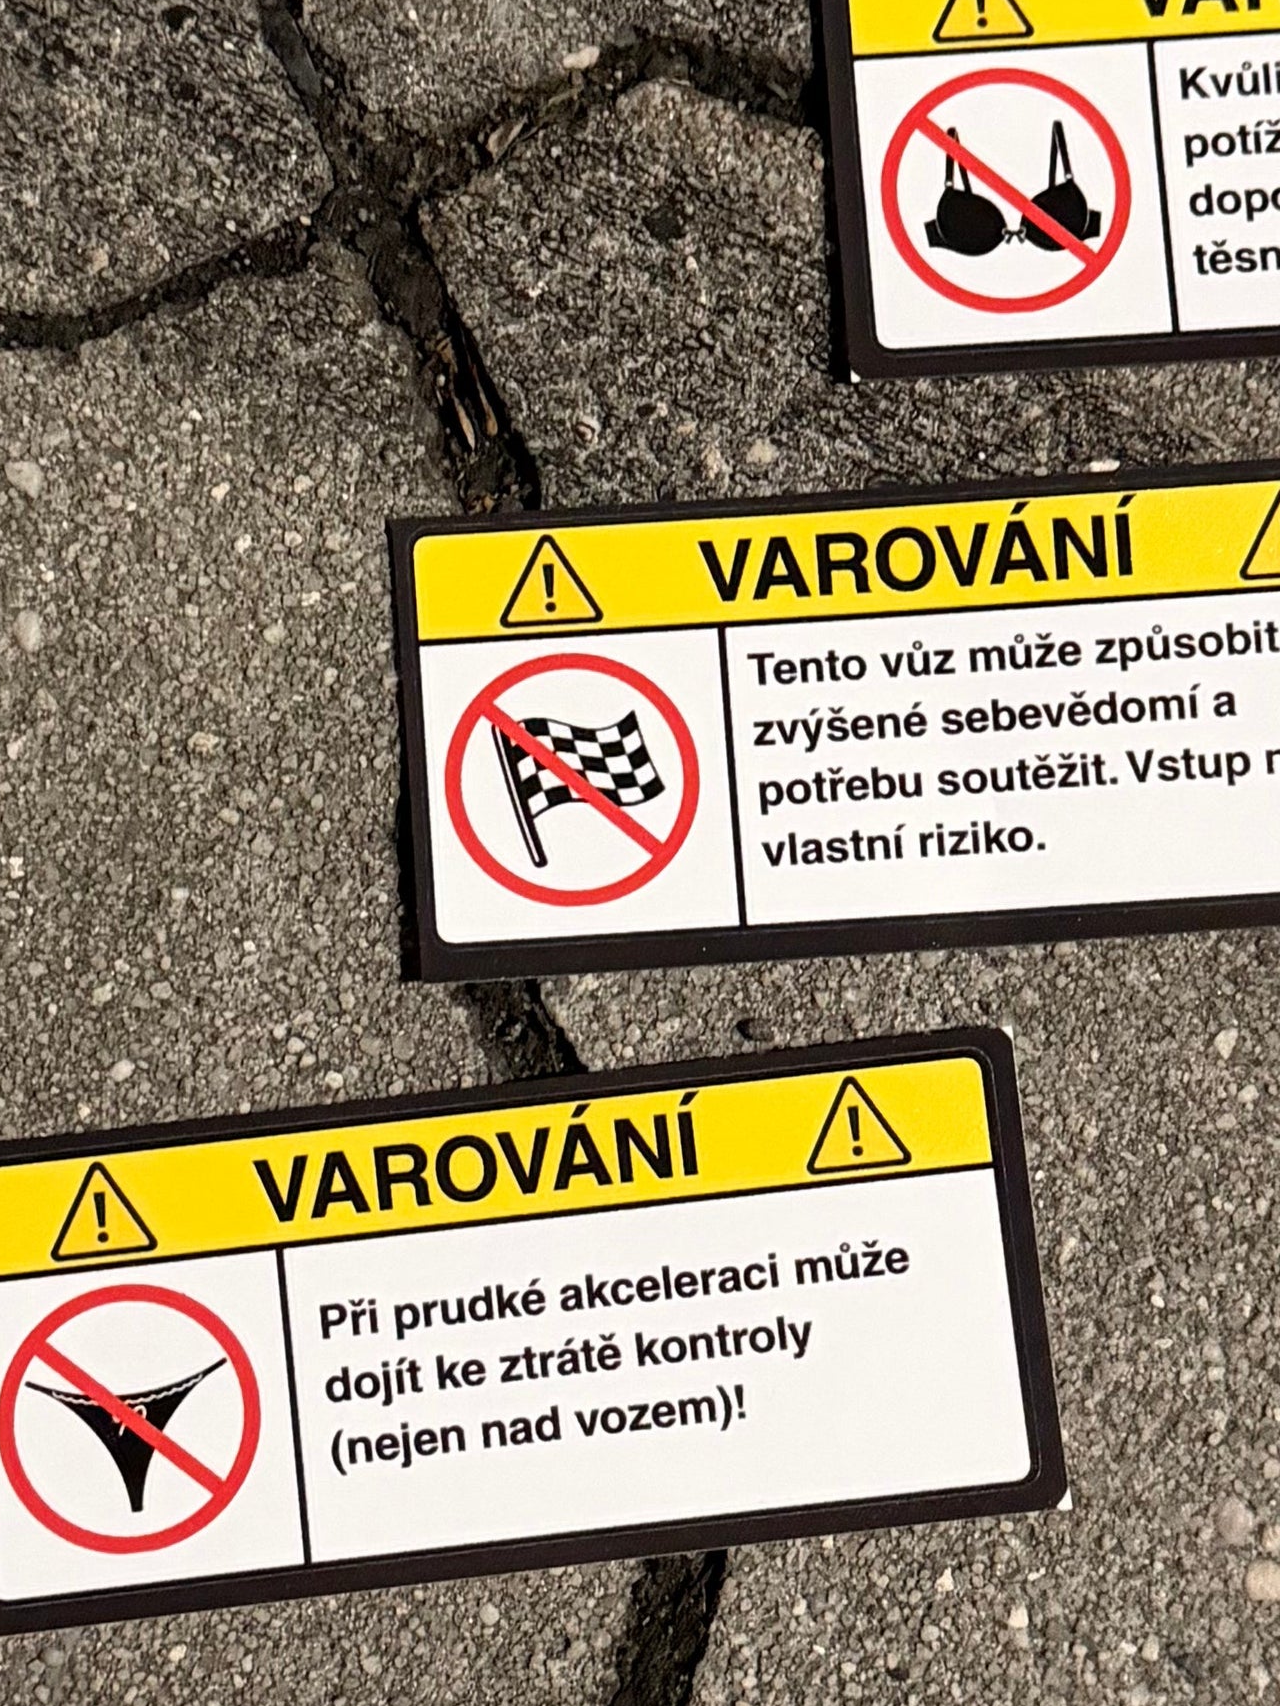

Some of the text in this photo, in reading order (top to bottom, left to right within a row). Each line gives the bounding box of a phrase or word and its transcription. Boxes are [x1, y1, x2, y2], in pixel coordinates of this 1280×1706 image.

[698, 496, 1133, 603] VAROVÁNÍ
[746, 619, 1280, 687] Tento vůz může způsobit
[752, 683, 1238, 754] zvýšené sebevědomí a
[757, 765, 924, 817] potřebu
[936, 751, 1119, 797] soutěžit.
[1124, 747, 1252, 787] Vstup
[760, 820, 1047, 868] vlastní riziko.
[251, 1090, 700, 1224] VAROVÁNÍ
[318, 1239, 910, 1342] Při prudké akceleraci může
[324, 1315, 813, 1408] dojít ke ztrátě kontroly
[330, 1383, 747, 1477] (nejen nad vozem)!
